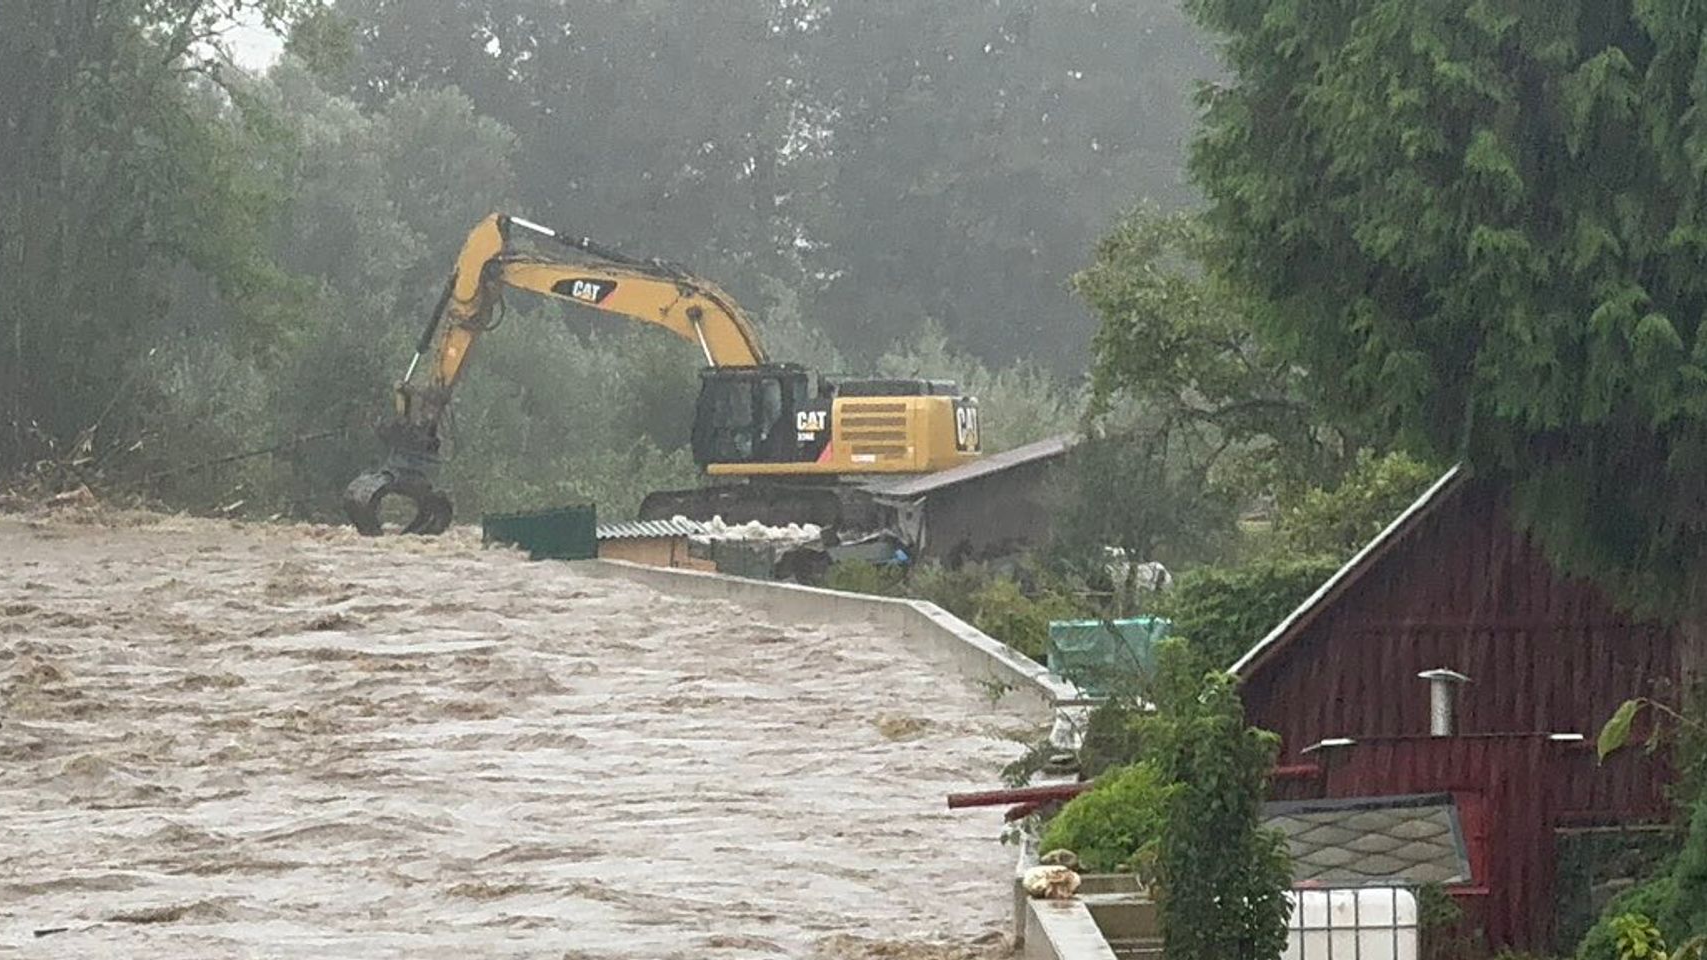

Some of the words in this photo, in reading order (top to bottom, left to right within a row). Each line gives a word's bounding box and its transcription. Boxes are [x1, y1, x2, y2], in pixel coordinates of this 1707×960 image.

[573, 280, 600, 301] CAT
[797, 411, 827, 430] CAT
[956, 407, 978, 445] CAT
